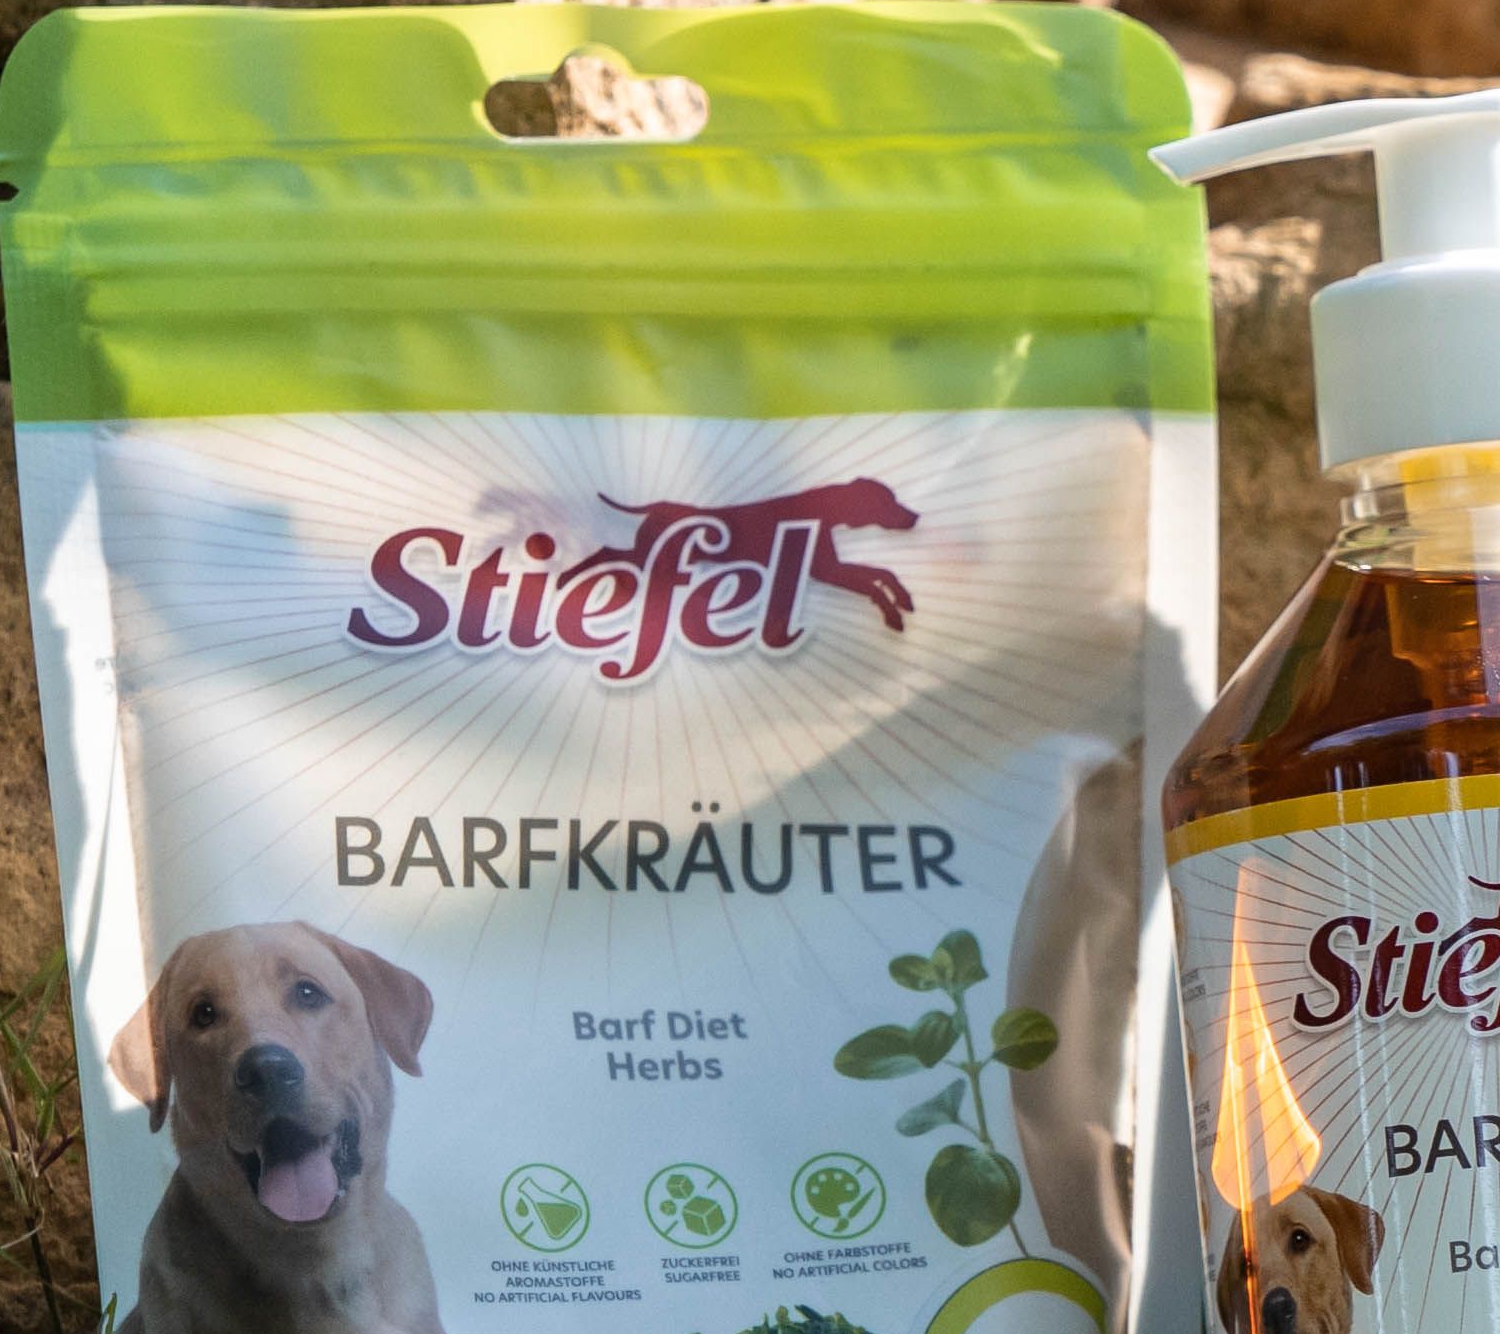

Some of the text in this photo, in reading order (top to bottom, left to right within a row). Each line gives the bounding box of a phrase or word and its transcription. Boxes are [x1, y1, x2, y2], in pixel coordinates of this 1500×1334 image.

[345, 518, 807, 681] Stiefel
[334, 801, 963, 895] BARFKRÄUTER
[571, 1009, 749, 1042] Barf Diet
[606, 1050, 723, 1081] Herbs
[660, 1255, 741, 1269] ZUCKERFREI
[783, 1242, 911, 1263] OHNE FARBSTOFFE
[491, 1256, 616, 1273] OHNE KÜNSTLICHE
[772, 1255, 928, 1279] NO ARTIFICIAL COLORS
[505, 1275, 605, 1288] AROMASTOFFE
[664, 1270, 741, 1284] SUGARFREE
[474, 1288, 642, 1303] NO ARTIFICIAL FLAVOURS
